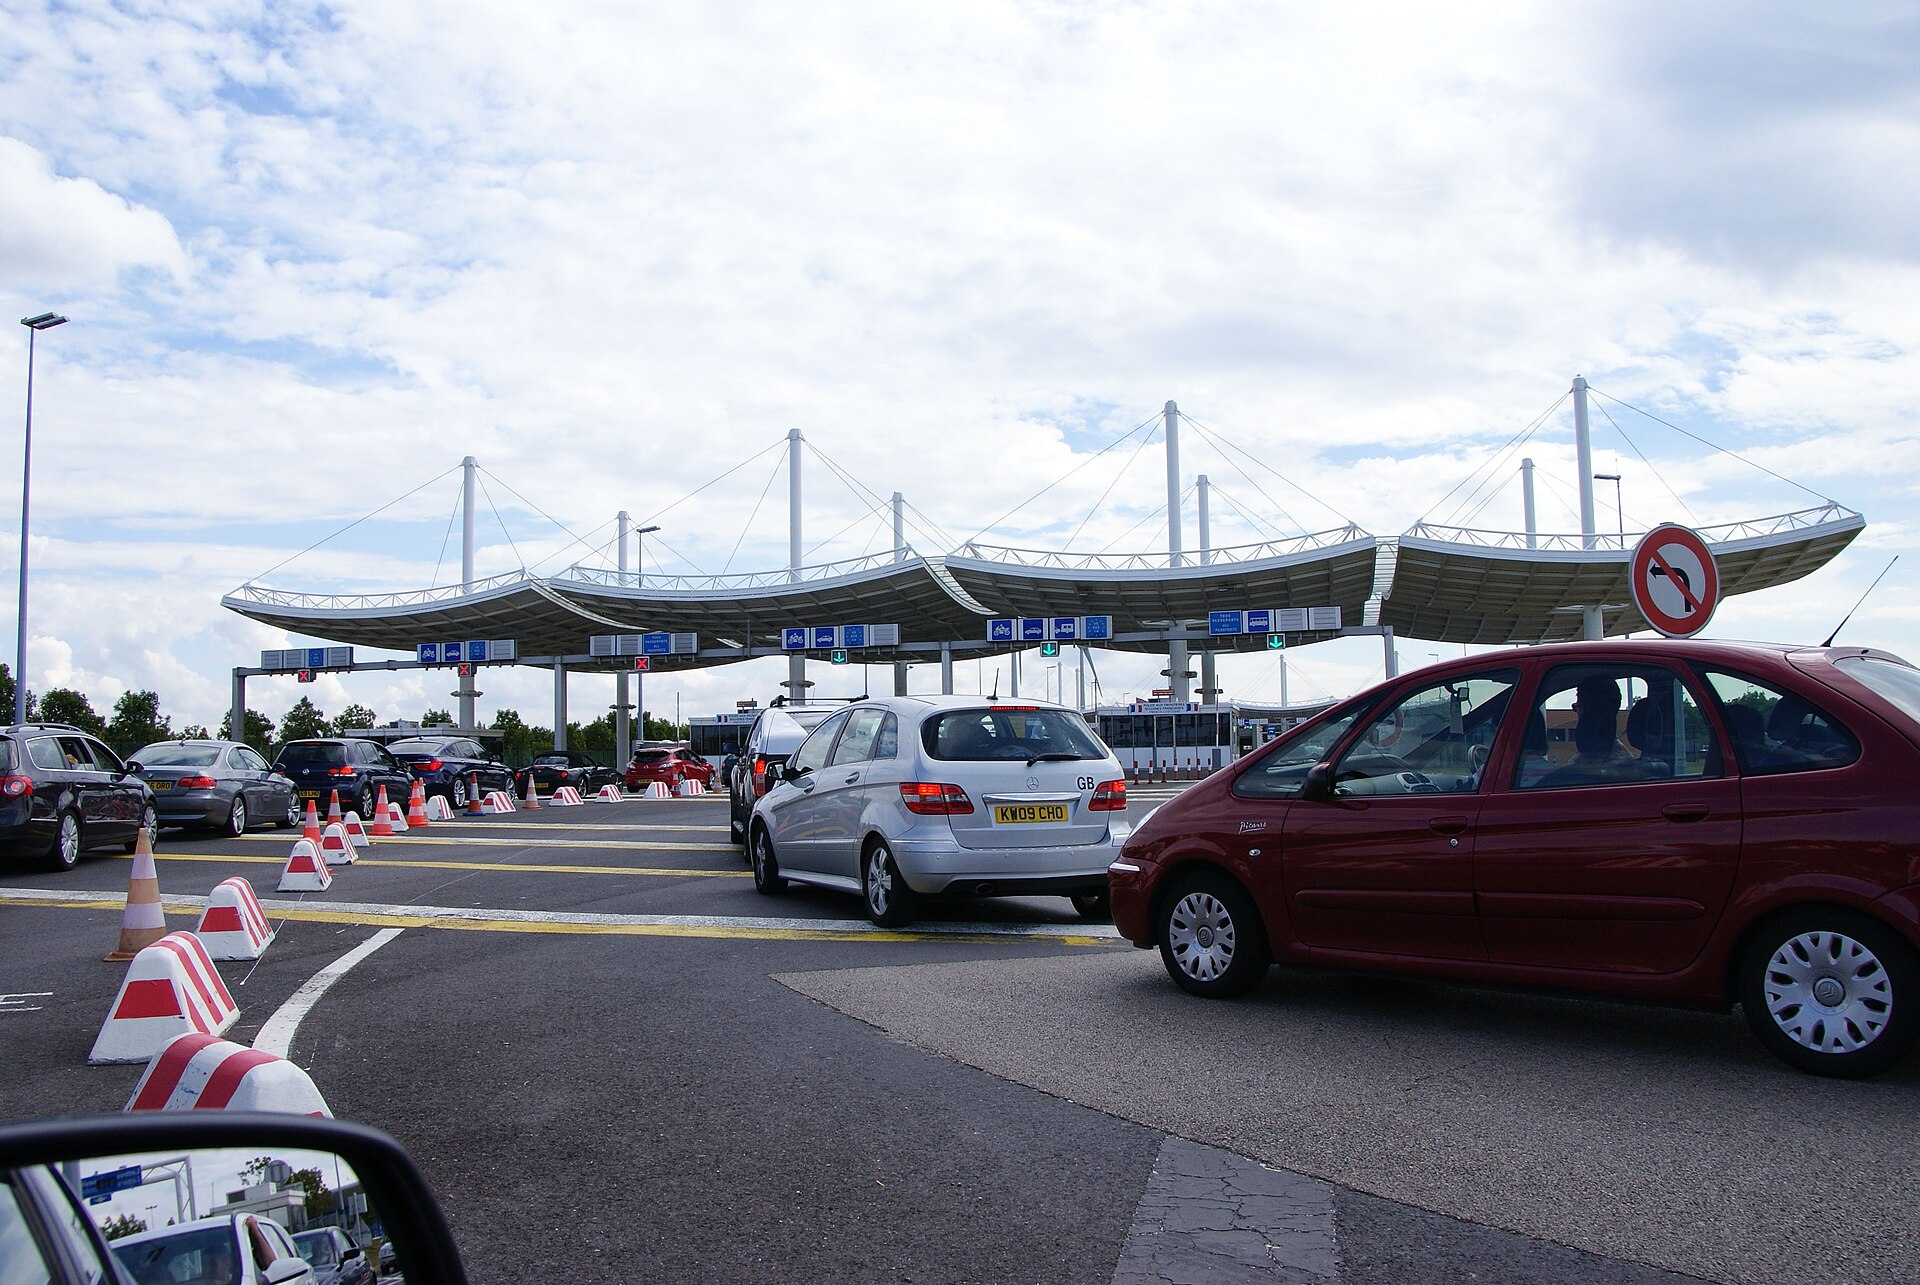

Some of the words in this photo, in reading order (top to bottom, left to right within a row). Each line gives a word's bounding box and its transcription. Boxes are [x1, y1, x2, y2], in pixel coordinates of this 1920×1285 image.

[1077, 776, 1095, 790] GB
[1000, 807, 1036, 821] KW09
[1039, 806, 1064, 820] CHO
